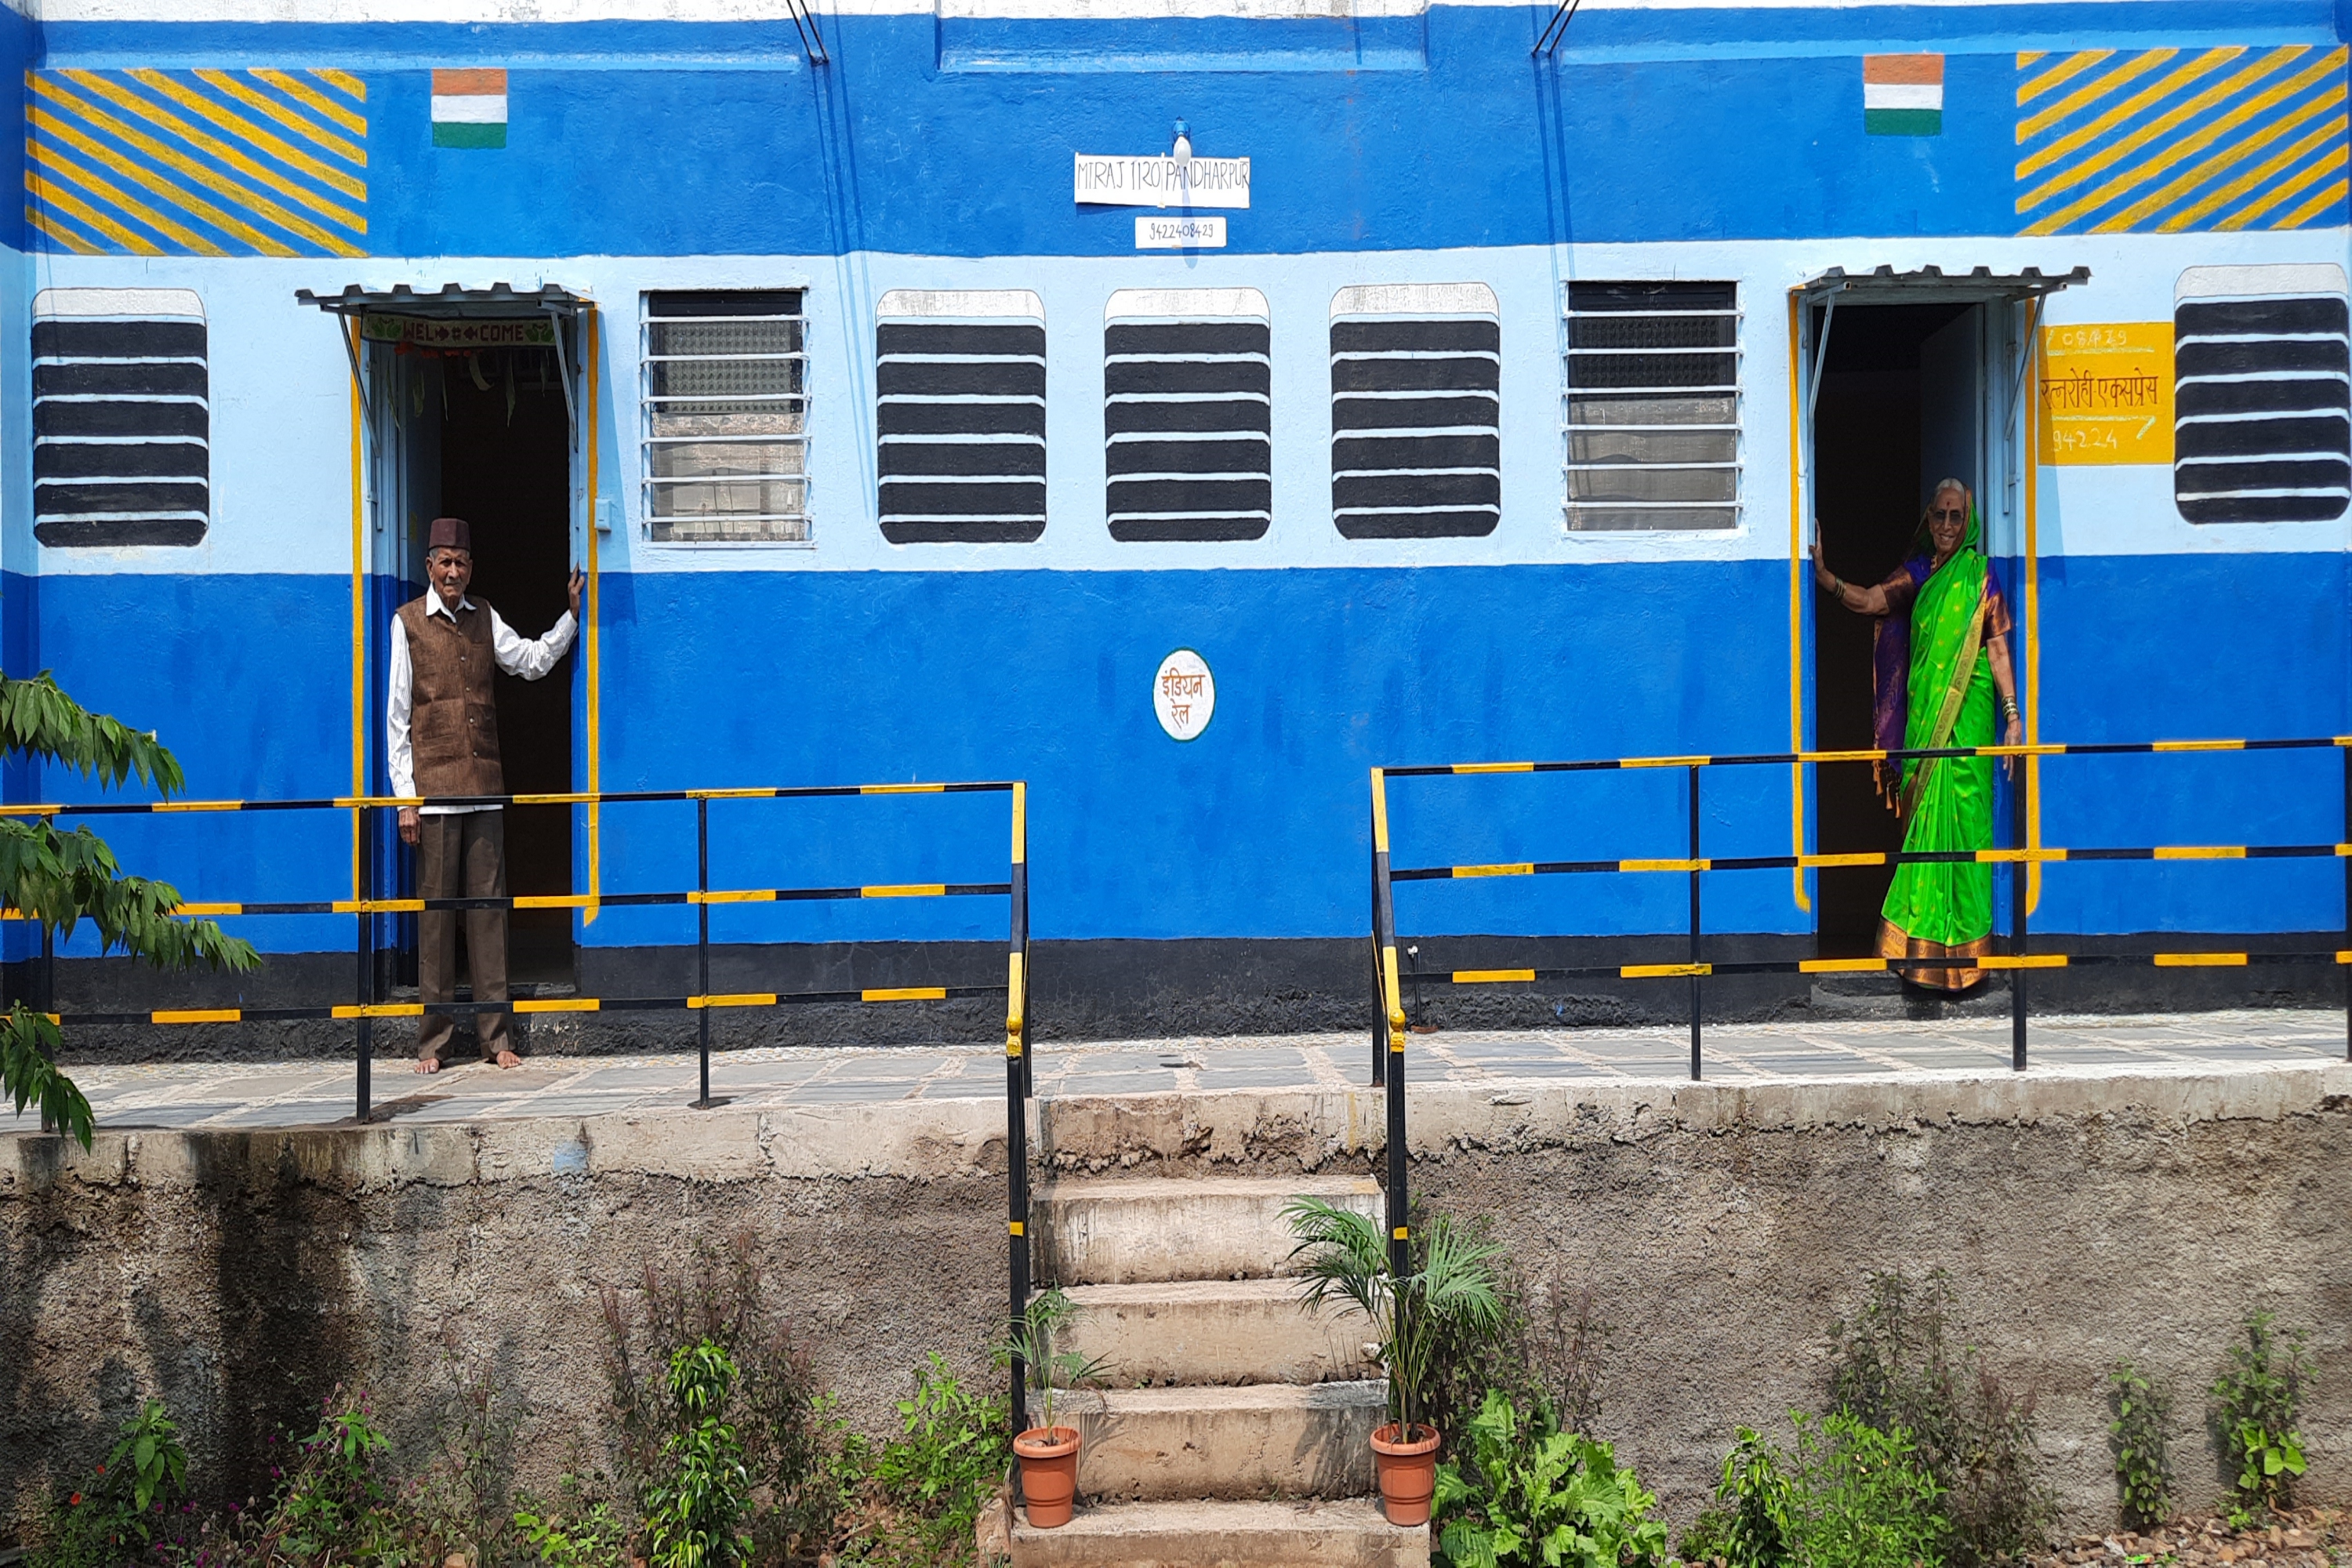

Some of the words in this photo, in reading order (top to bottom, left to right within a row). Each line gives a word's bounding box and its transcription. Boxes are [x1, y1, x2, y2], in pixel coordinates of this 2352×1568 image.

[1077, 161, 1124, 190] MIRAJ
[1166, 161, 1250, 191] PANDHARPUR
[1149, 223, 1213, 240] 9422408429
[2052, 427, 2118, 452] 94224
[1161, 666, 1206, 699] इंडियन
[1170, 698, 1191, 730] रेल
